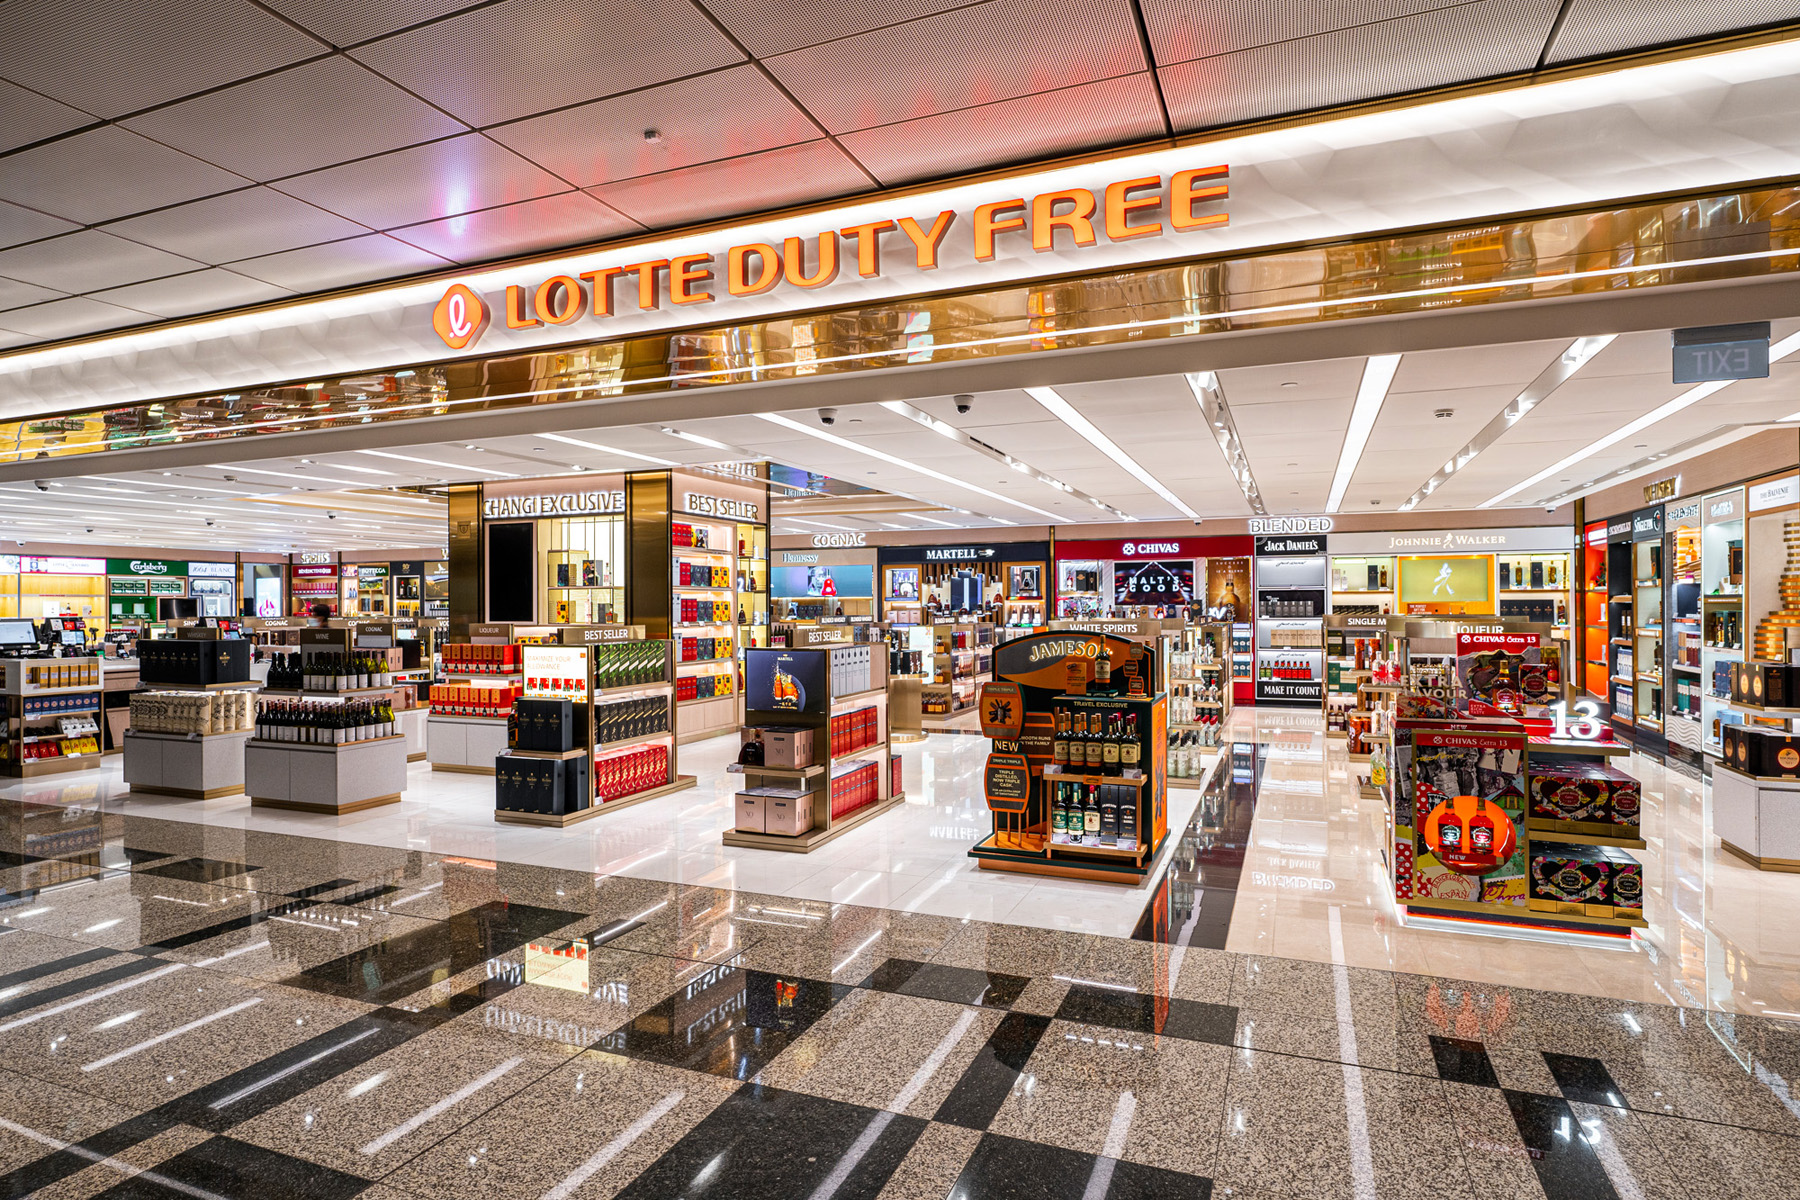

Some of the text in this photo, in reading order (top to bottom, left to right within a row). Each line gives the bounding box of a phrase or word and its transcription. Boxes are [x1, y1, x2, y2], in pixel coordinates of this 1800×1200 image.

[505, 164, 1230, 329] LOTTE DUTY FREE
[482, 492, 623, 517] CHANGI EXCLUSIVE
[688, 493, 759, 519] BEST SELLER
[1250, 517, 1333, 534] BLENDED
[812, 533, 866, 547] COGNAC
[1264, 539, 1318, 551] JACK DANIEL'S
[1389, 535, 1506, 548] JOHNNIE WALKER
[926, 548, 977, 560] MARTELL
[1137, 542, 1180, 554] CHIVAS
[783, 553, 819, 564] Hennessy
[130, 560, 168, 574] Carlsberg
[1129, 584, 1180, 593] GOOD
[264, 619, 289, 627] COGNAC
[1070, 623, 1138, 633] WHITE SPIRITS
[1347, 618, 1376, 626] SINGLE
[584, 629, 628, 640] BEST SELLER
[808, 631, 842, 643] BEST SELLER
[1473, 635, 1505, 643] CHIVAS
[1029, 640, 1110, 662] JAMESO
[1400, 674, 1463, 689] EXTRA
[1264, 685, 1321, 696] MAKE IT COUNT
[1396, 688, 1468, 700] FLAVOUR
[1096, 701, 1128, 709] EXCLUSIVE
[1549, 700, 1601, 739] 13
[994, 740, 1019, 752] NEW
[1445, 737, 1478, 746] CHIVAS
[1499, 739, 1508, 747] 13
